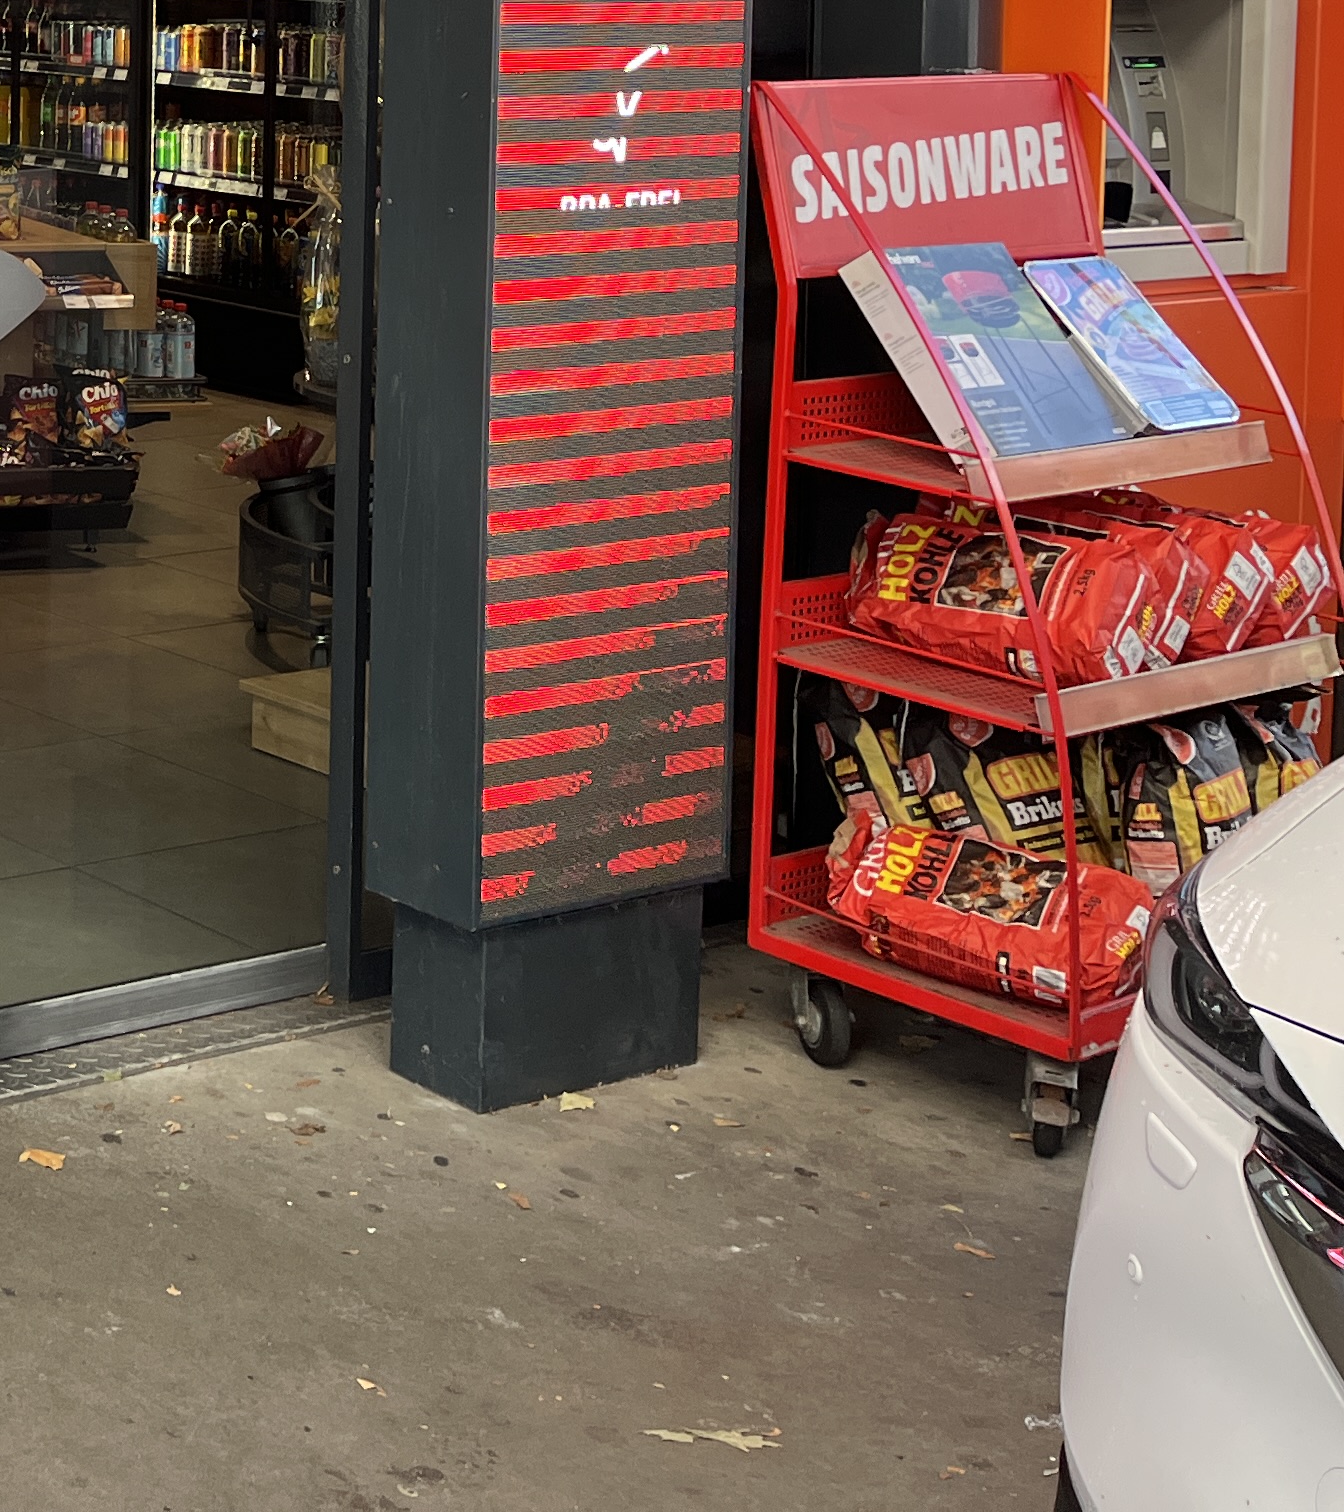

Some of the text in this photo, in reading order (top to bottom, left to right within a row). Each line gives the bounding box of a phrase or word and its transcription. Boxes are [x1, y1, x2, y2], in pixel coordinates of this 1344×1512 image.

[791, 121, 1069, 223] SAISONWARE
[19, 383, 58, 402] Chio
[82, 381, 119, 404] Chio
[878, 524, 936, 601] HOLZ
[910, 527, 966, 604] KOHLE
[875, 823, 930, 895] HOLZ
